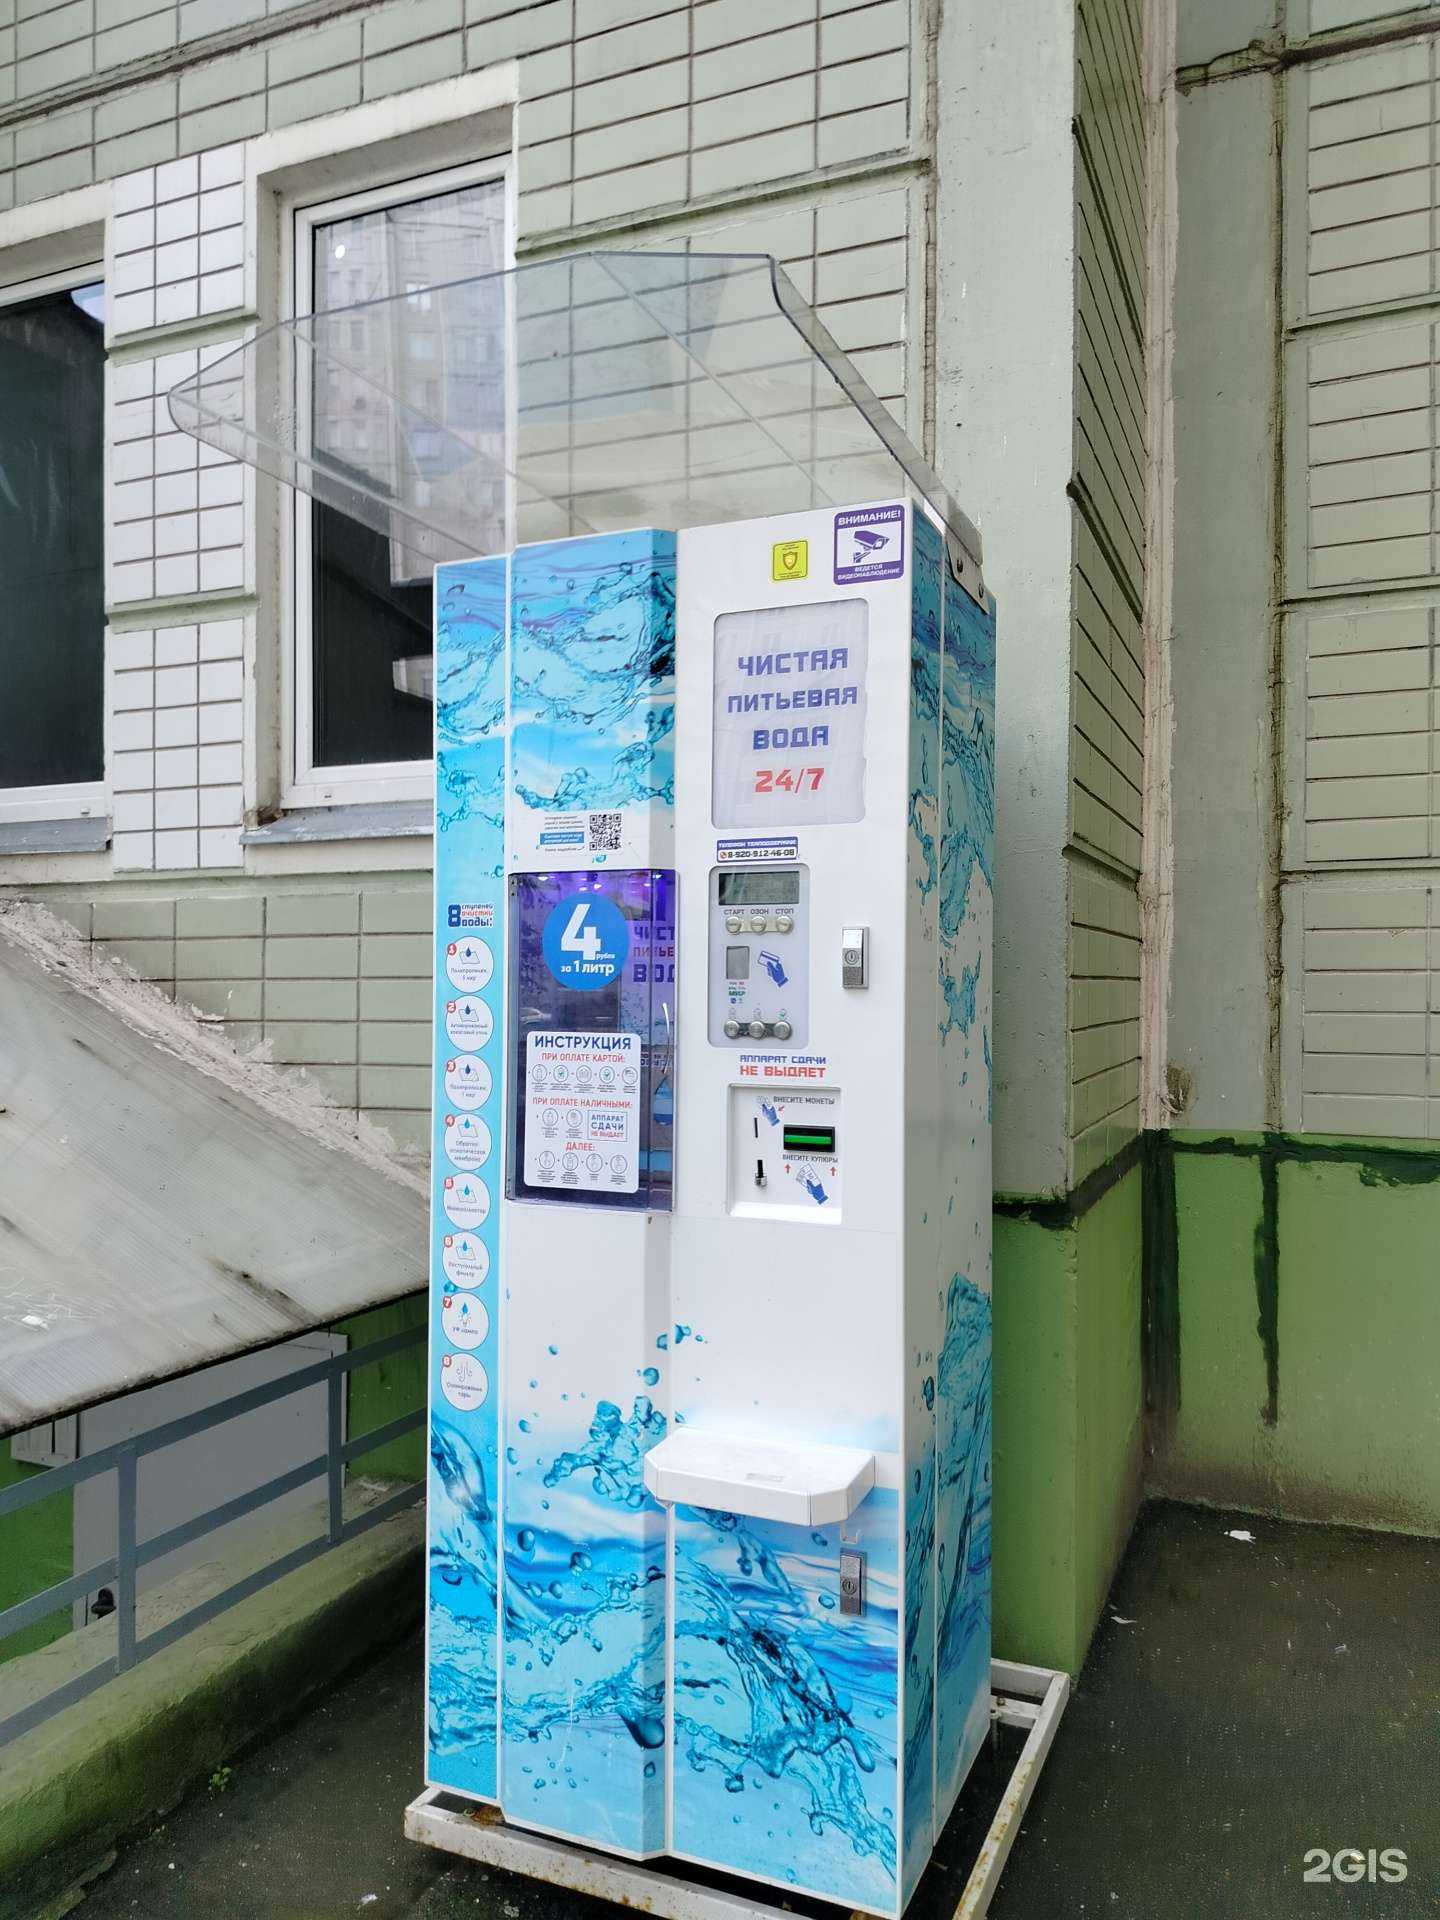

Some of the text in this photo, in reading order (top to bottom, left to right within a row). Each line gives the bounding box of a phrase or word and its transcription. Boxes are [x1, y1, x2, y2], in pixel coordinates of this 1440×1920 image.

[838, 510, 901, 526] ВНИМАНИЕ!
[837, 567, 900, 580] ВИДЕОНАБЛЮДЕНИЕ
[854, 563, 883, 572] ВЕДЕТСЯ
[737, 648, 849, 677] ЧИСТАЯ
[727, 686, 858, 713] ПИТЬЕВАЯ
[752, 725, 829, 750] ВОДА
[754, 767, 825, 794] 24/7
[447, 904, 461, 927] 8
[775, 907, 794, 915] СТОП
[461, 917, 493, 927] воды:
[560, 903, 602, 960] 4
[560, 960, 615, 977] за 1 литр
[534, 1035, 632, 1051] ИНСТРУКЦИЯ
[541, 1052, 558, 1061] ПРИ
[560, 1053, 590, 1062] ОПЛАТЕ
[739, 1054, 827, 1065] АППАРАТ СДАЧИ
[740, 1065, 827, 1078] НЕ ВЫДАЕТ
[532, 1096, 548, 1106] ПРИ
[549, 1097, 578, 1107] ОПЛАТЕ
[773, 1095, 836, 1106] ВНЕСИТЕ МОНЕТЫ
[590, 1114, 625, 1122] АППАРАТ
[590, 1121, 625, 1131] СДАЧИ
[565, 1141, 596, 1152] ДАЛЕЕ:
[782, 1154, 810, 1162] ВНЕСИТЕ
